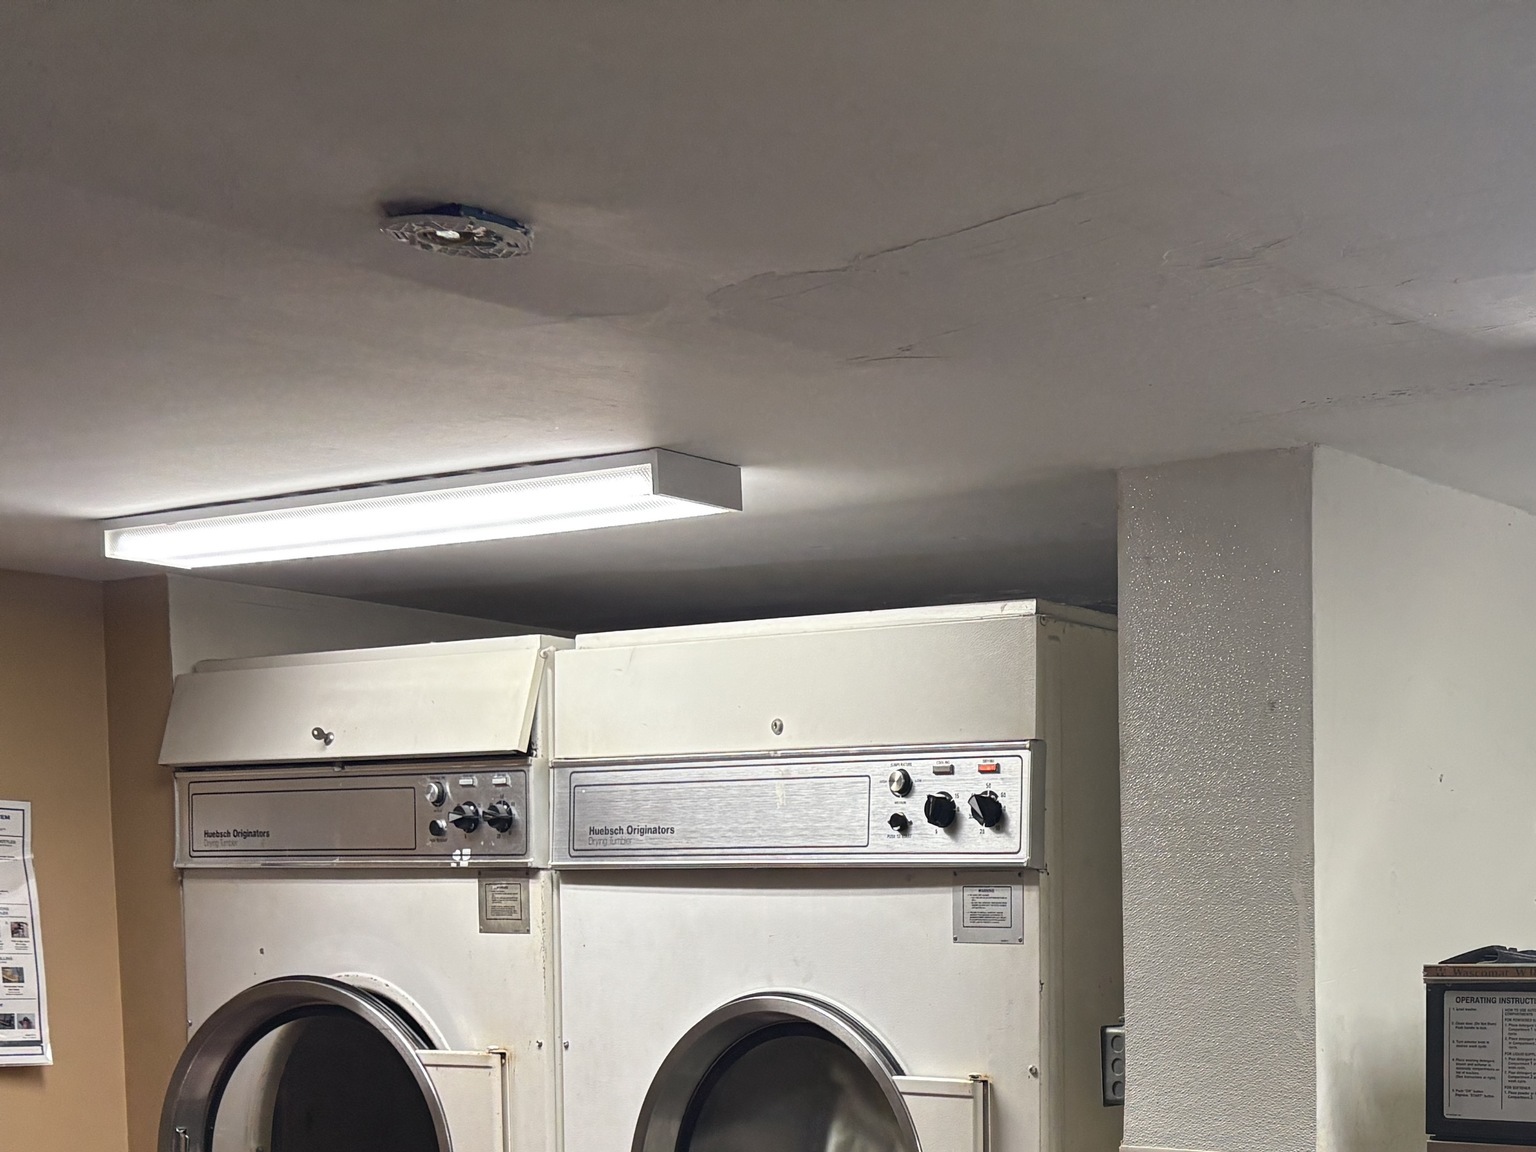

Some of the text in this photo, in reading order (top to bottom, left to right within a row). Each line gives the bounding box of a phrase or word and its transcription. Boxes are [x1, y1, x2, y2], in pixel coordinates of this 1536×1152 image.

[204, 829, 270, 839] Huebsch Originators
[588, 825, 675, 836] Huebsch Originators
[1452, 968, 1510, 977] Wascomat
